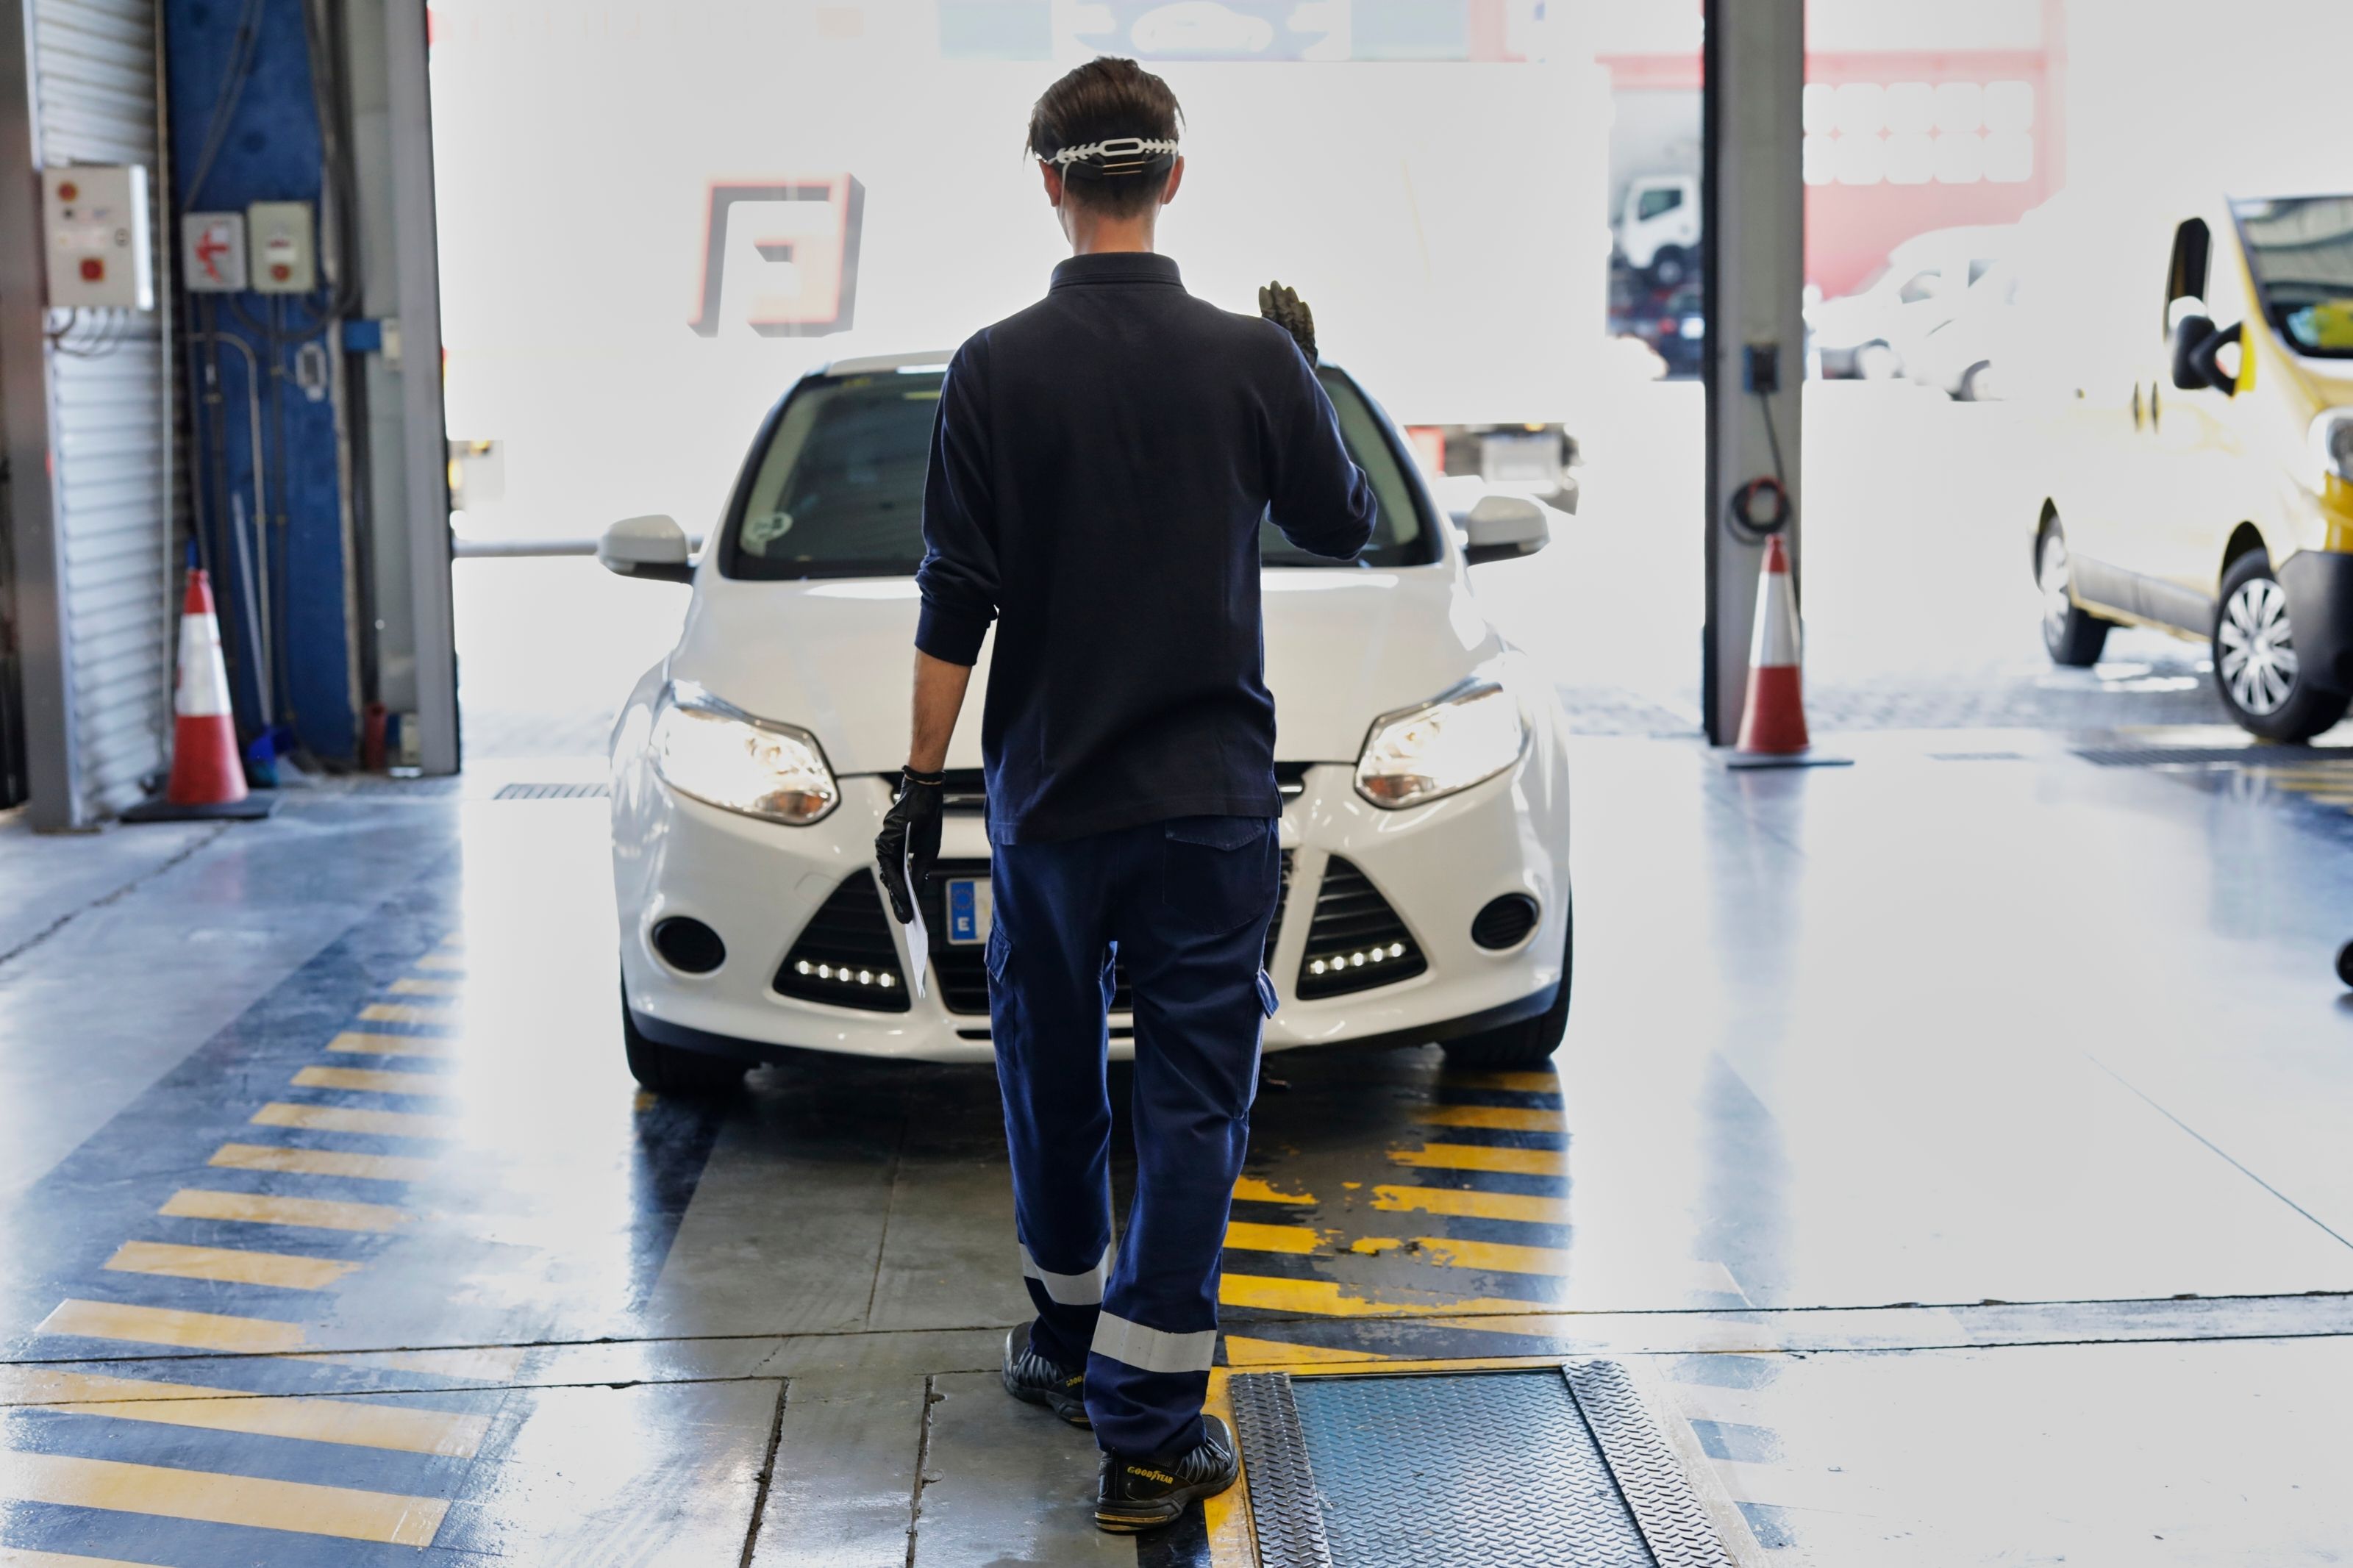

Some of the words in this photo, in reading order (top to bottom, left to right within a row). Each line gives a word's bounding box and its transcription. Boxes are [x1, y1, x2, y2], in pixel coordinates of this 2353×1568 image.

[957, 917, 970, 931] E
[1065, 1375, 1084, 1388] GOOD
[1127, 1466, 1174, 1484] GOODYEAR
